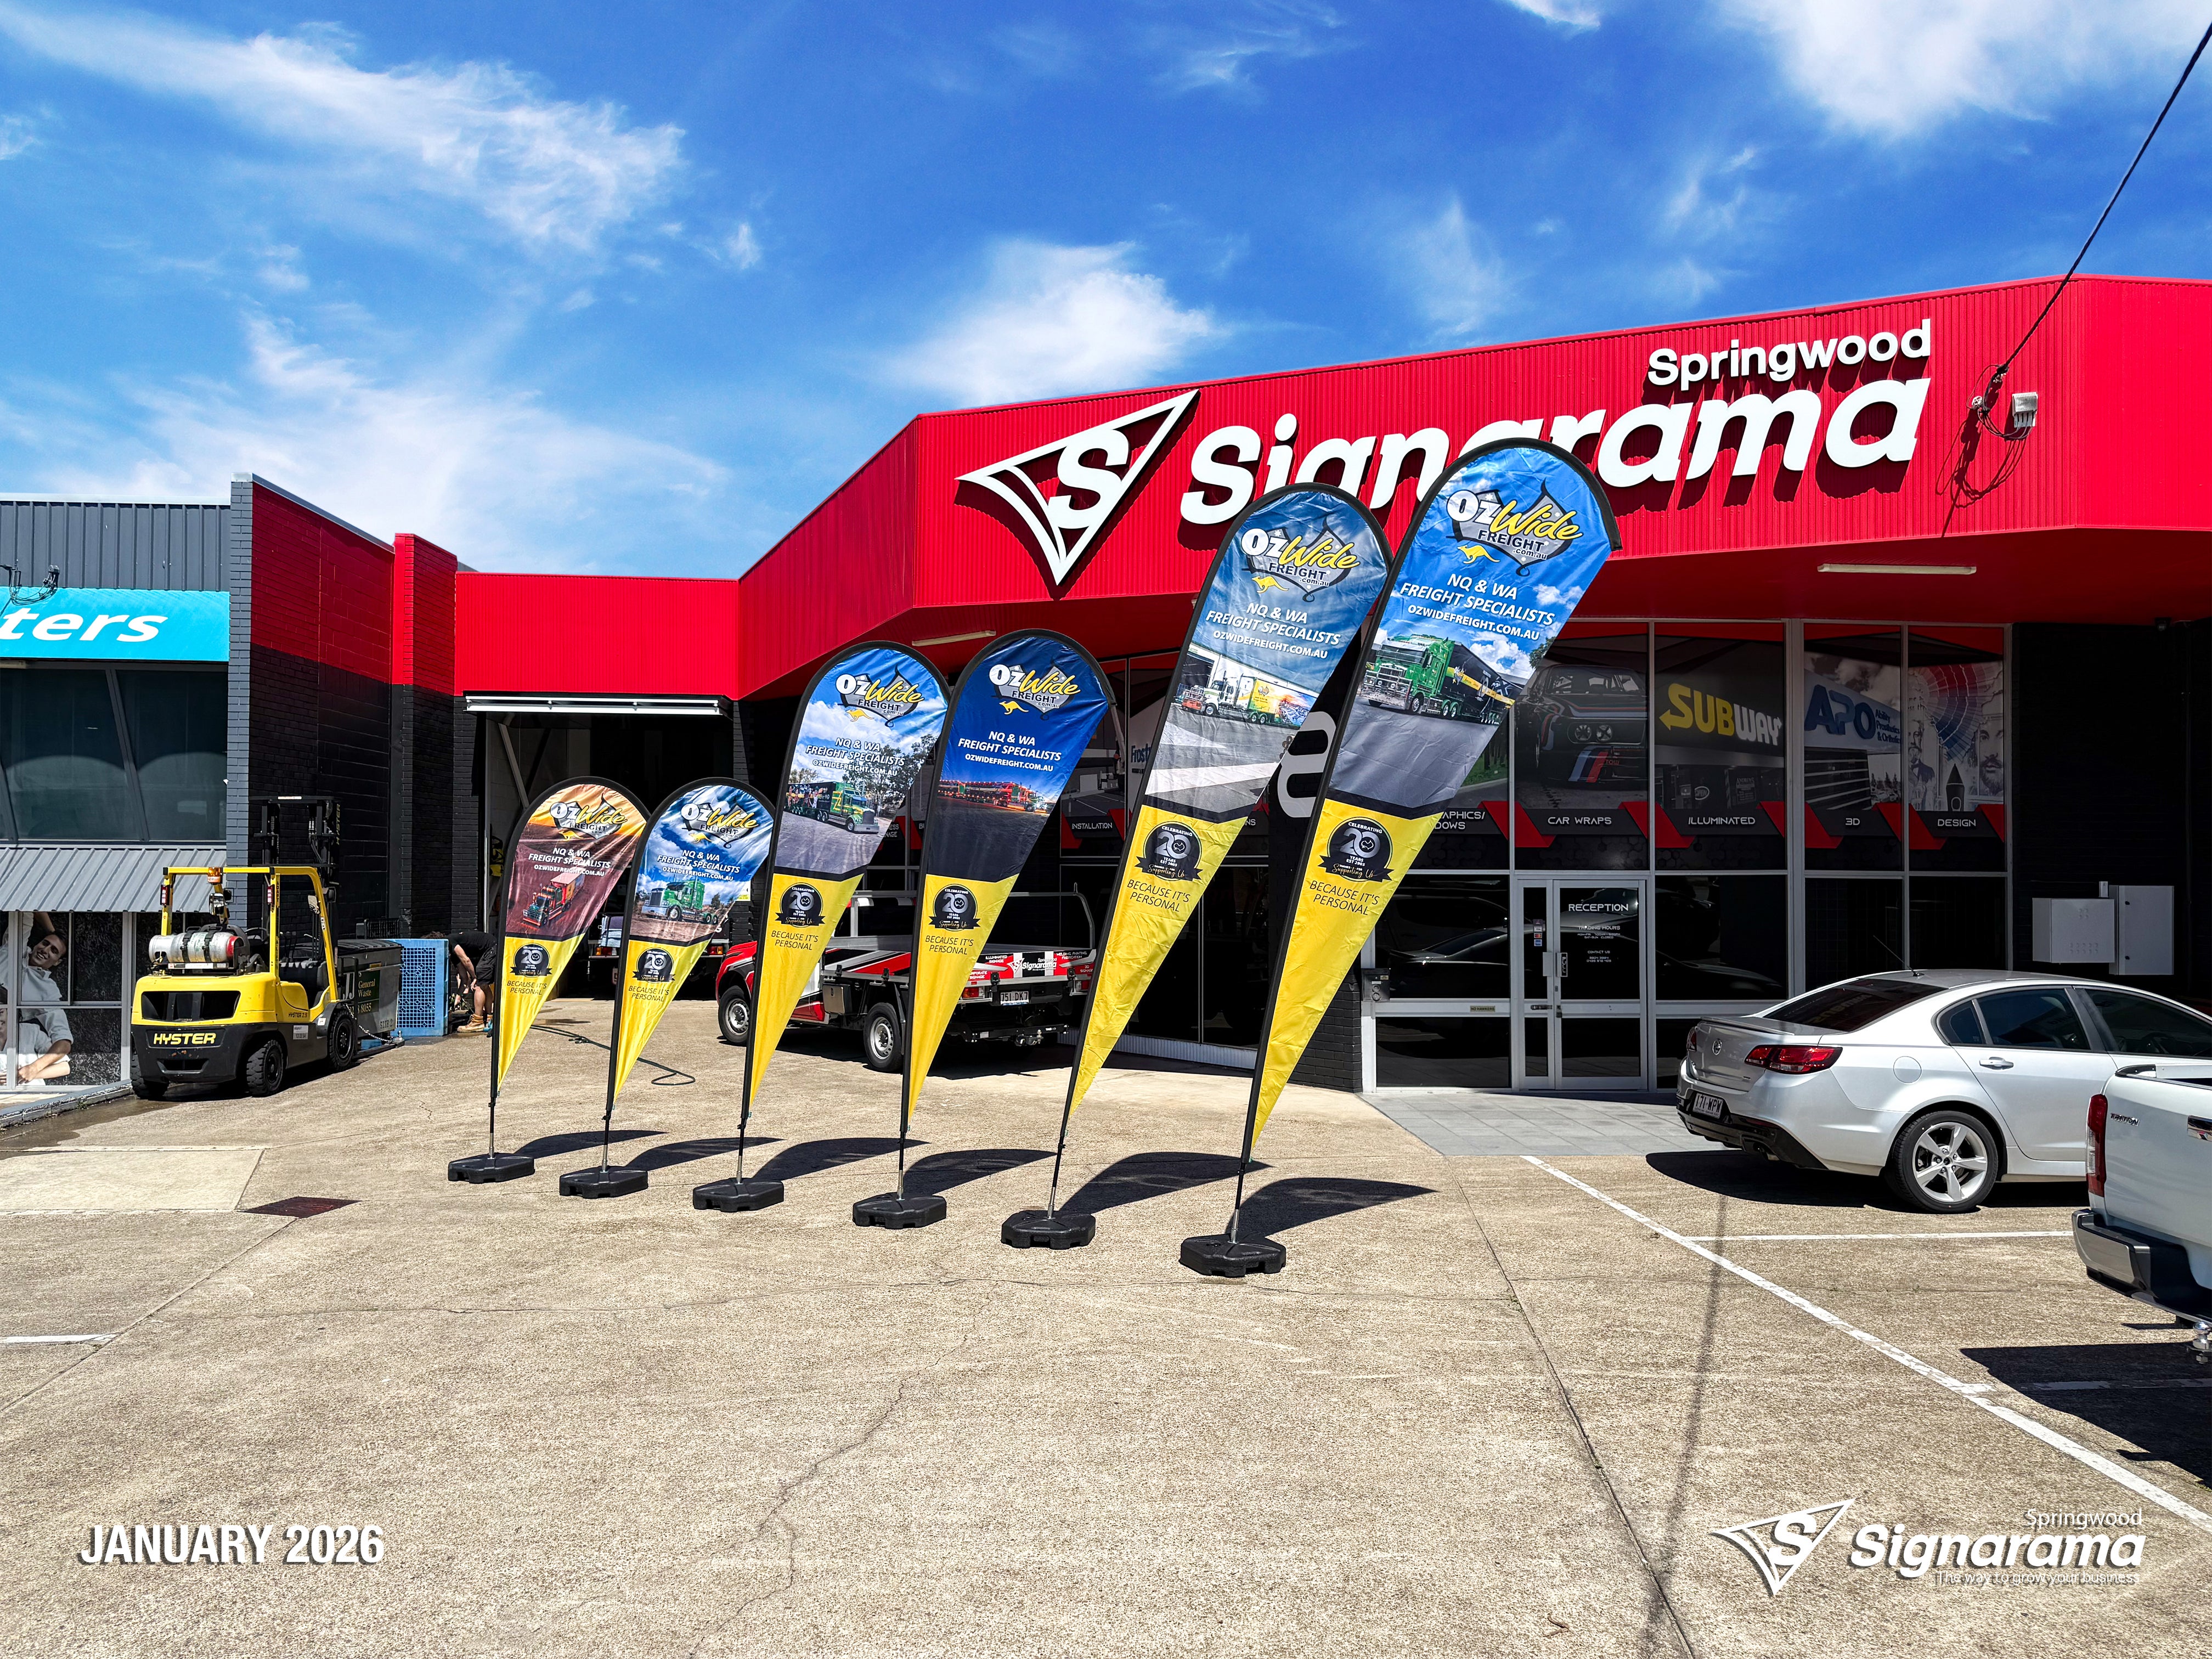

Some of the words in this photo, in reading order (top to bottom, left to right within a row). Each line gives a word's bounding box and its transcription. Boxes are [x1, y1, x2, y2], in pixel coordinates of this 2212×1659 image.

[1647, 318, 1931, 391] Springwood
[1181, 378, 1931, 524] Signrama
[1477, 529, 1545, 552] FREIGHT
[1513, 549, 1547, 560] .com.au
[1269, 563, 1327, 580] FREIGHT
[1447, 573, 1473, 591] NQ
[1474, 579, 1487, 594] &
[1492, 583, 1517, 600] WA
[1400, 583, 1463, 607] FREIGHT
[1464, 595, 1555, 626] SPECIALISTS
[1246, 602, 1268, 618] NQ
[1270, 607, 1282, 620] &
[1286, 609, 1307, 624] WA
[0, 608, 168, 642] ters
[1206, 611, 1261, 631] FREIGHT
[1261, 621, 1341, 646] SPECIALISTS
[1408, 605, 1540, 641] OZWIDEFREIGHT.COM.AU
[1213, 630, 1328, 659] OZWIDEFREIGHT.COM.AU
[1012, 691, 1057, 703] FREIGHT
[857, 699, 901, 712] FREIGHT
[1804, 684, 1876, 740] APO
[1659, 683, 1782, 746] SUBWAY
[836, 737, 852, 748] NQ
[853, 740, 861, 749] &
[864, 741, 881, 752] WA
[989, 731, 1005, 742] NQ
[1007, 733, 1016, 743] &
[1018, 735, 1035, 746] WA
[806, 744, 846, 759] FREIGHT
[849, 751, 905, 766] SPECIALISTS
[958, 738, 1000, 753] FREIGHT
[1001, 745, 1062, 761] SPECIALISTS
[812, 760, 898, 776] OZWIDEFREIGHT.COM.AU
[964, 753, 1053, 771] OZWIDEFREIGHT.COM.AU
[1441, 811, 1485, 820] APHICS/
[1548, 816, 1570, 825] CAR
[1575, 816, 1612, 825] WRAPS
[1688, 816, 1756, 825] ILLUMINATED
[1845, 818, 1860, 826] 3D
[1937, 819, 1976, 827] DESIGN
[569, 823, 607, 832] FREIGHT
[700, 825, 738, 835] FREIGHT
[1161, 826, 1192, 837] CELEBRATING
[1348, 822, 1383, 834] CELEBRATING
[1154, 831, 1191, 859] 20
[1340, 828, 1380, 858] 20
[552, 848, 566, 856] NQ
[682, 850, 696, 858] NQ
[706, 853, 720, 861] WA
[528, 854, 562, 864] FREIGHT
[563, 857, 611, 868] SPECIALISTS
[657, 855, 691, 866] FREIGHT
[692, 860, 741, 874] SPECIALISTS
[534, 864, 605, 876] OZWIDEFREIGHT.COM.AU
[663, 866, 733, 881] OZWIDEFREIGHT.COM.AU
[1332, 863, 1363, 878] Supporting
[1127, 879, 1171, 898] BECAUSE
[1172, 891, 1190, 902] IT'S
[1310, 881, 1359, 900] BECAUSE
[1359, 893, 1380, 905] IT'S
[789, 891, 814, 911] 20
[942, 893, 968, 913] 20
[1130, 891, 1179, 912] PERSONAL
[1313, 894, 1368, 915] PERSONAL
[1568, 904, 1628, 912] RECEPTION
[771, 930, 804, 941] BECAUSE
[926, 935, 958, 945] BECAUSE
[775, 940, 812, 950] PERSONAL
[929, 945, 968, 955] PERSONAL
[521, 950, 543, 964] 20
[644, 953, 667, 970] 20
[1022, 961, 1057, 970] Signarama
[358, 979, 376, 989] General
[629, 985, 657, 994] BECAUSE
[358, 989, 371, 997] Waste
[631, 993, 664, 1002] PERSONAL
[153, 1032, 217, 1045] HYSTER
[2111, 1113, 2140, 1126] TRITON
